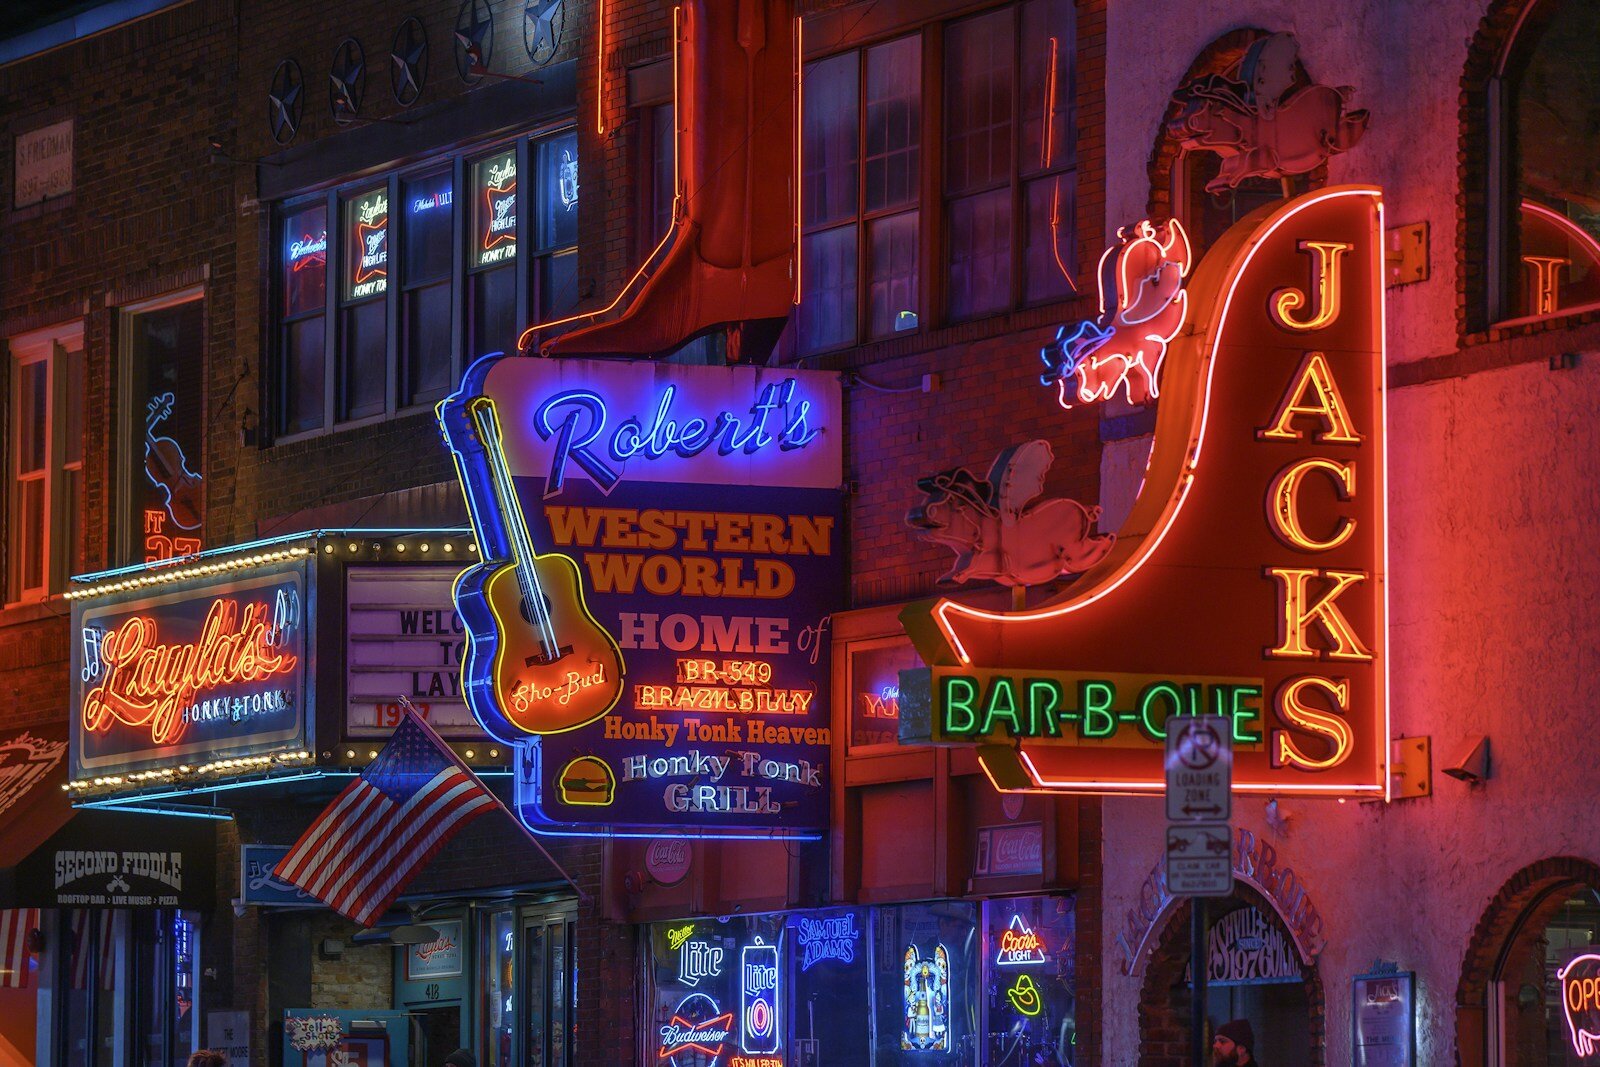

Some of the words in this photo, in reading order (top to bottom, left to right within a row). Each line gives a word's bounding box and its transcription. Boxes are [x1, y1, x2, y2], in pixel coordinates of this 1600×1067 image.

[534, 378, 818, 500] Robert's
[544, 505, 834, 556] WESTERN
[584, 553, 796, 600] WORLD
[619, 612, 789, 654] HOME
[797, 616, 830, 665] of
[84, 599, 283, 744] Layla's
[677, 658, 772, 687] BR-549
[512, 664, 605, 713] Sho-Bud
[182, 696, 231, 724] HONKY
[242, 689, 287, 716] TONK
[375, 703, 430, 727] 197
[604, 715, 679, 747] Honky
[684, 718, 741, 742] Tonk
[747, 720, 830, 745] Heaven
[622, 750, 730, 783] Honky
[739, 750, 822, 787] Tonk
[1175, 773, 1220, 787] LOADING
[664, 783, 781, 814] GRILL
[1184, 788, 1211, 802] ZONE
[55, 851, 117, 889] SECOND
[122, 852, 181, 891] FIDDLE
[58, 894, 89, 904] ROOFTOP
[91, 895, 105, 904] BAR
[112, 895, 127, 904] LIVE
[128, 895, 152, 905] MUSIC
[158, 896, 178, 905] PIZZA
[667, 924, 695, 950] Miller
[799, 913, 858, 944] SAMUEL
[1002, 930, 1039, 953] Coors
[678, 941, 723, 986] Lite
[802, 939, 853, 971] ADAMS
[1008, 950, 1032, 962] LIGHT
[1228, 945, 1272, 980] 1976
[745, 963, 776, 997] Lite
[660, 1024, 728, 1045] Budweiser
